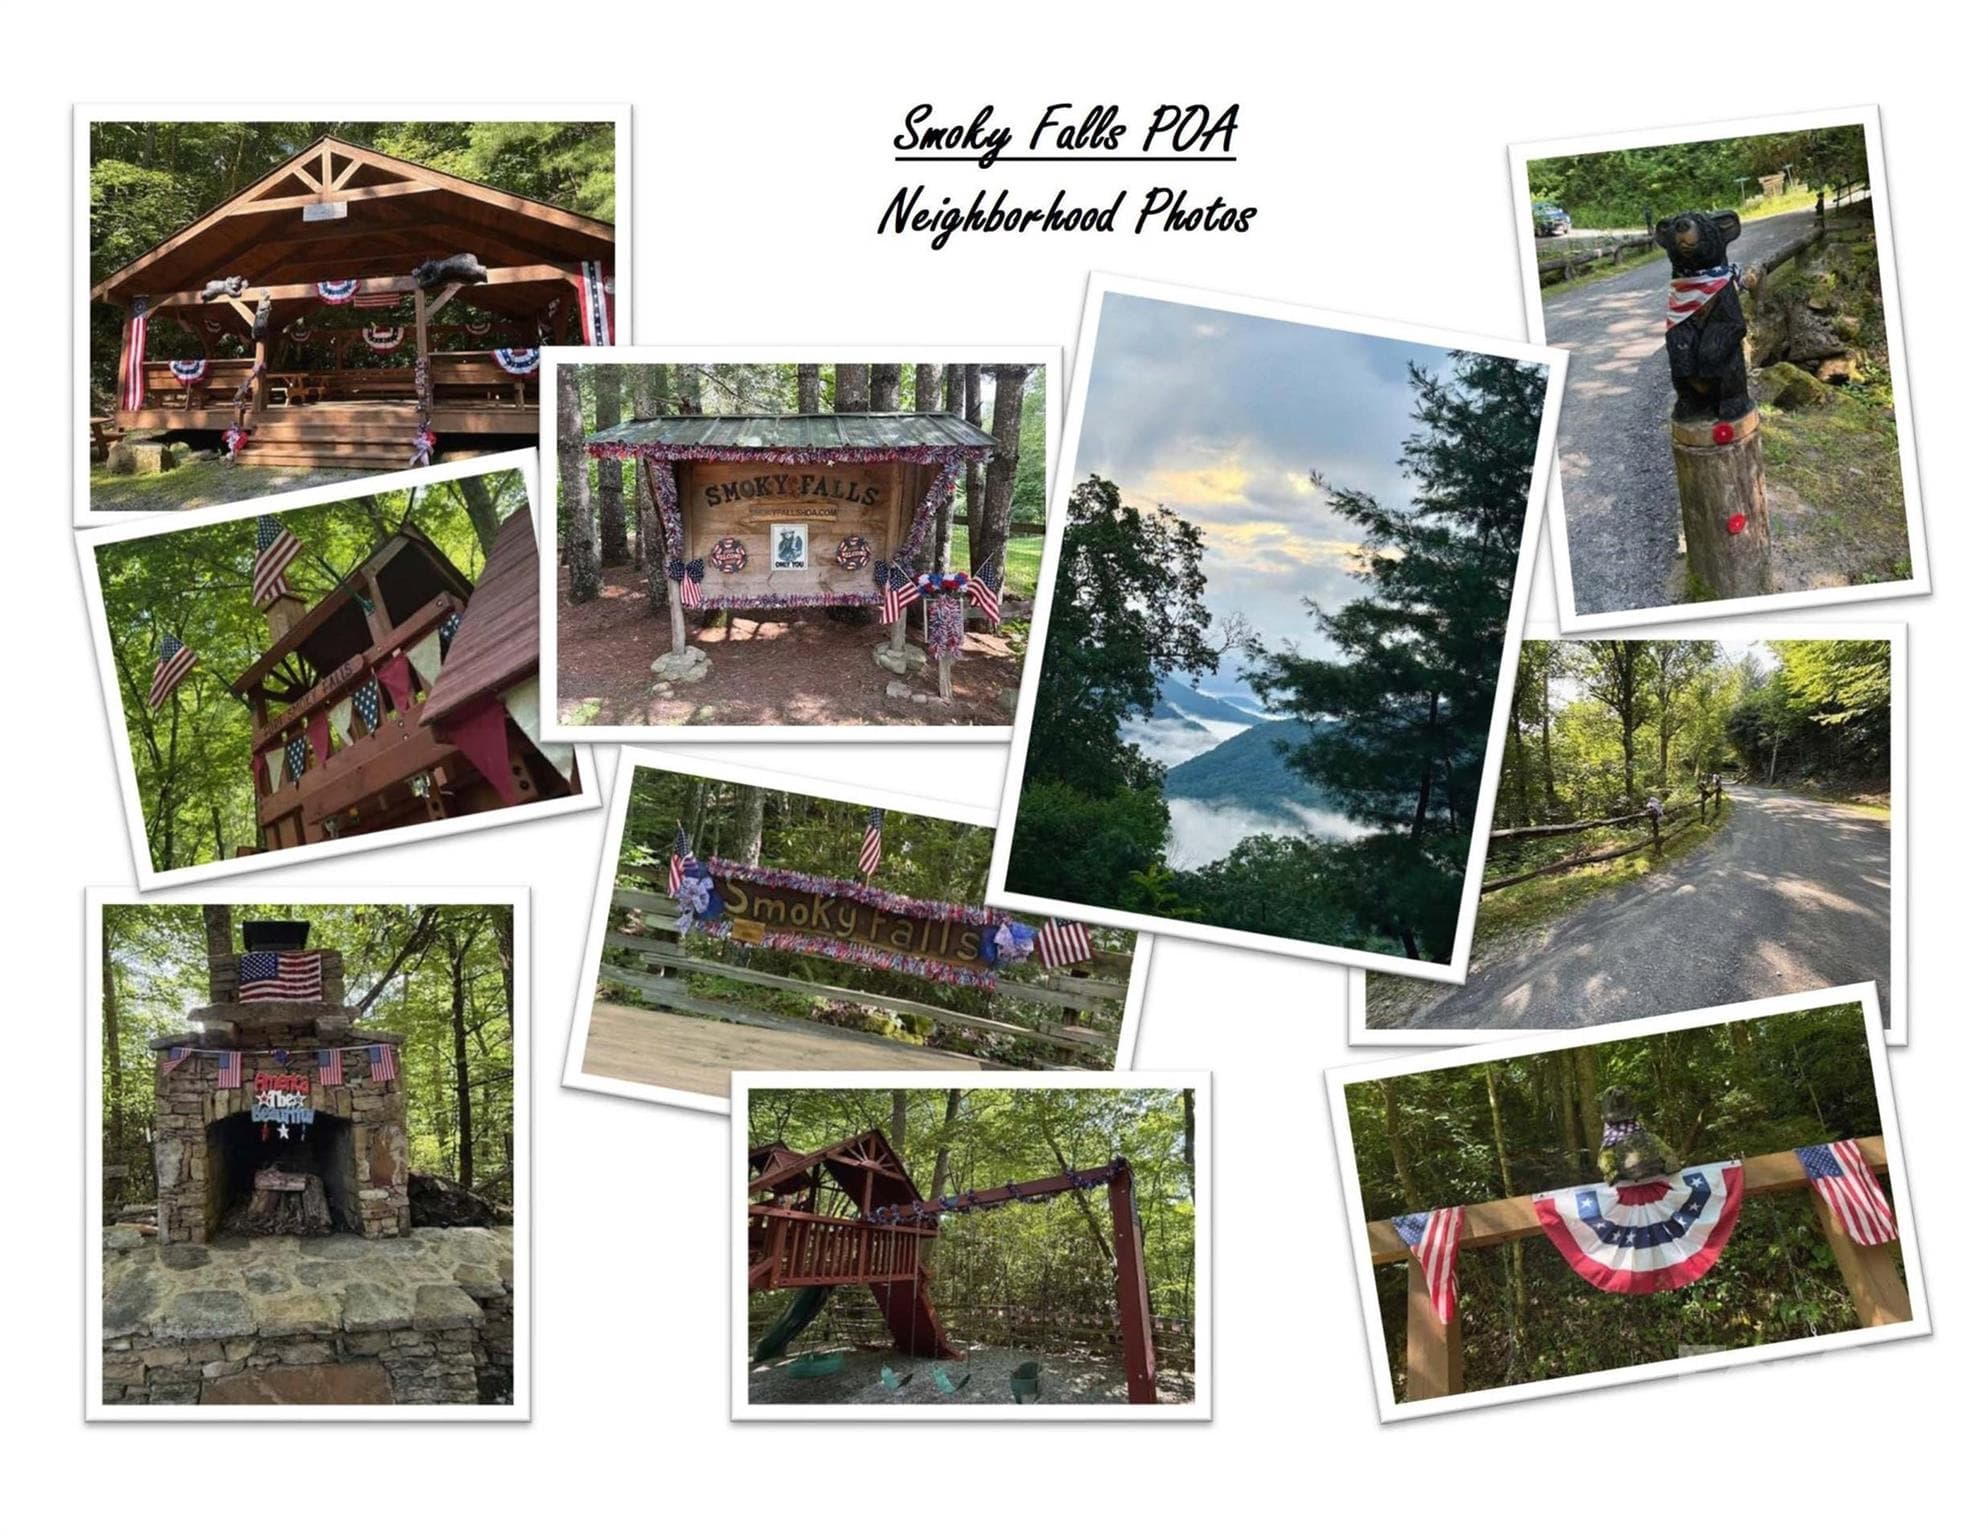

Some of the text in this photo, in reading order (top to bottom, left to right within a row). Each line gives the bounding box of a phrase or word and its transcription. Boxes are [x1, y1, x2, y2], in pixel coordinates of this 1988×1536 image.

[704, 474, 880, 507] SMOKY FALLS
[322, 661, 353, 694] FALLS
[267, 1089, 294, 1108] The
